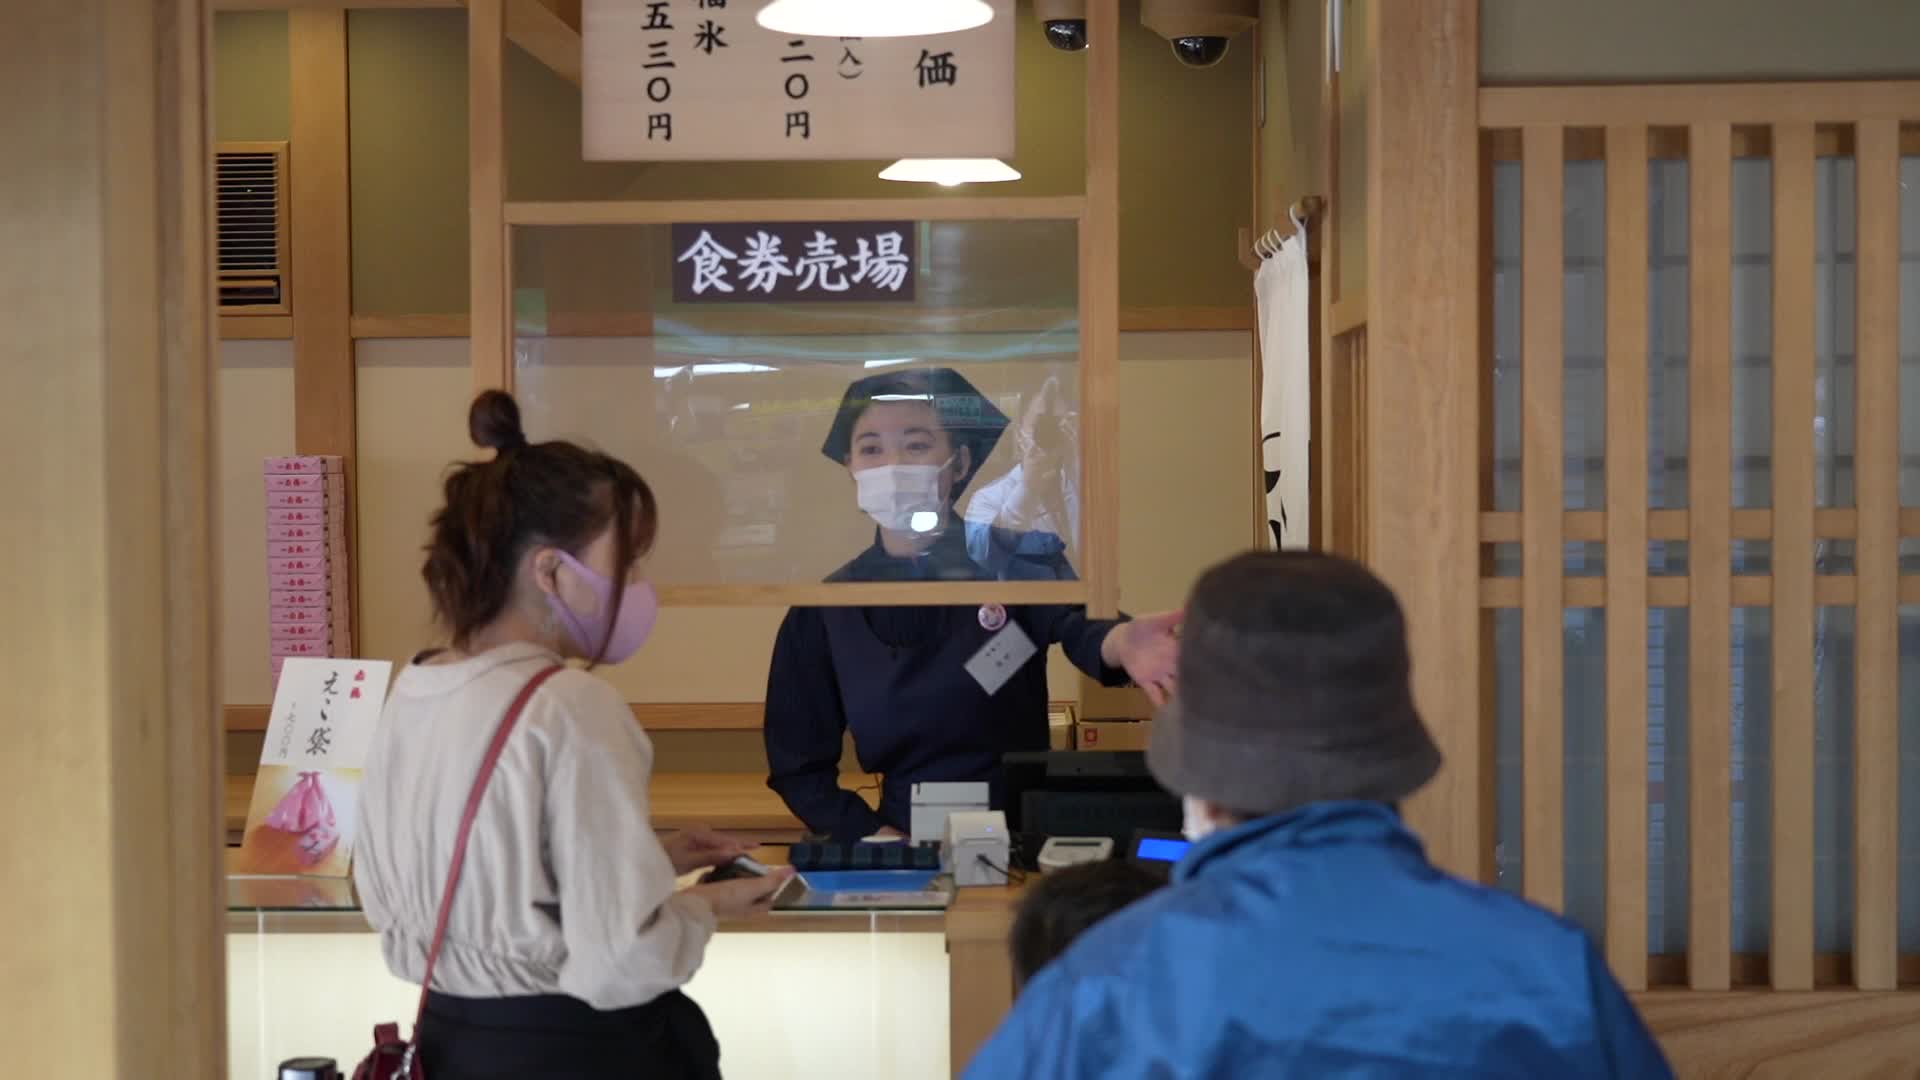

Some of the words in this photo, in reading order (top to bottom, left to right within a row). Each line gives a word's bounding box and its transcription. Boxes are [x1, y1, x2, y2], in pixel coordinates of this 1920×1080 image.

[694, 0, 729, 55] 氷
[838, 36, 864, 80] 入）
[915, 49, 957, 88] 価
[677, 230, 909, 294] 食券売場
